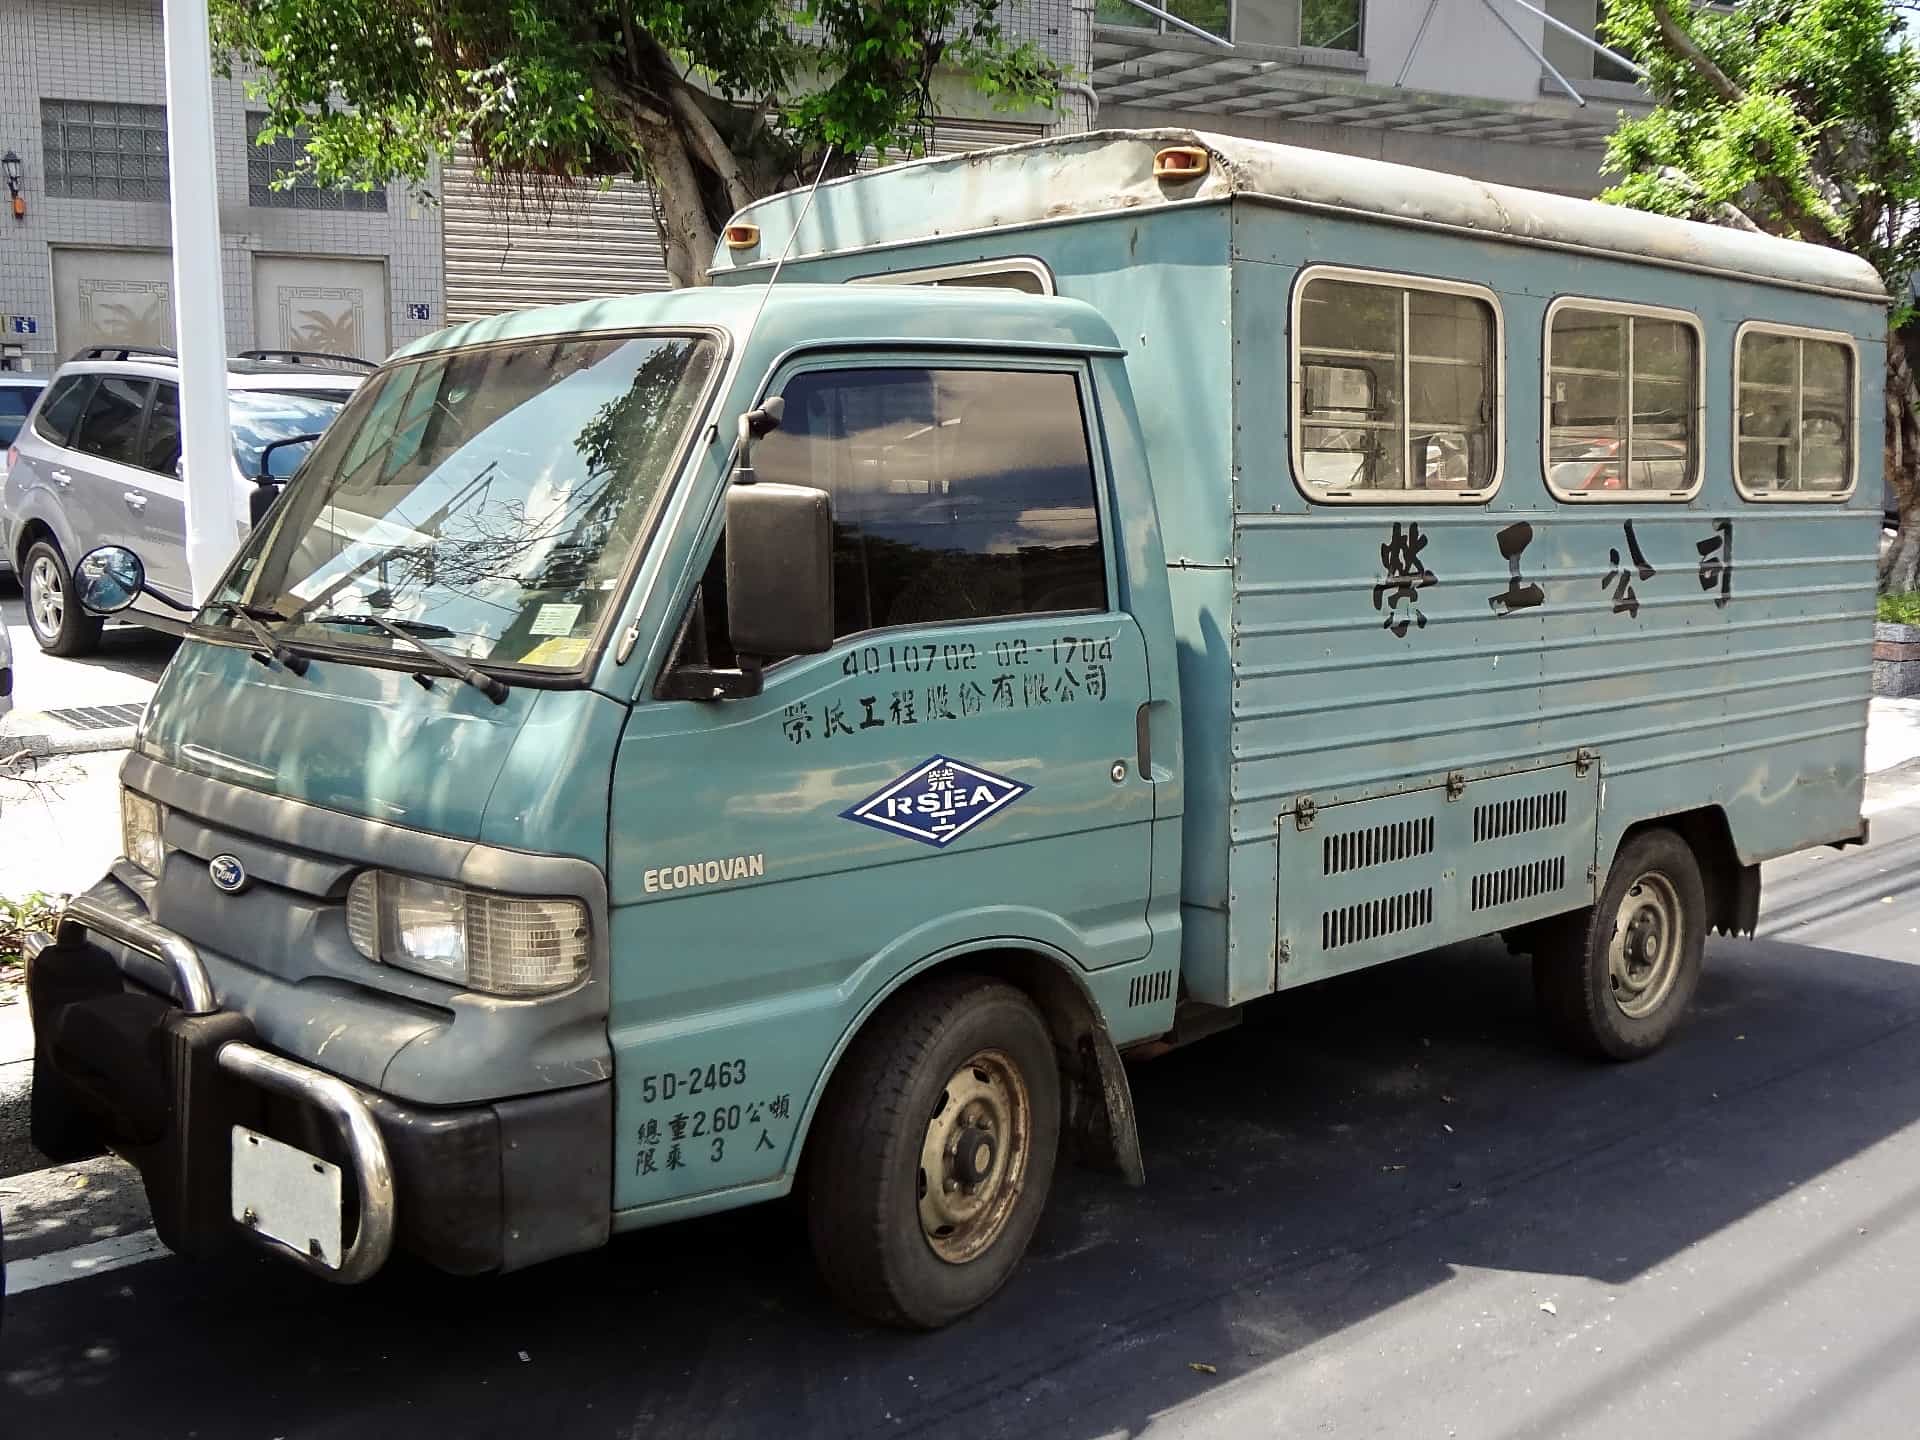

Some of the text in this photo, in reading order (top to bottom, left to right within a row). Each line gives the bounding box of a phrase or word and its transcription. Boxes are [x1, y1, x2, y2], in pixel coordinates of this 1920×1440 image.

[842, 637, 1113, 677] 4010702 02-1704
[887, 785, 997, 818] RSEA
[643, 853, 764, 893] ECONOVAN
[642, 1058, 747, 1104] 5D-2463
